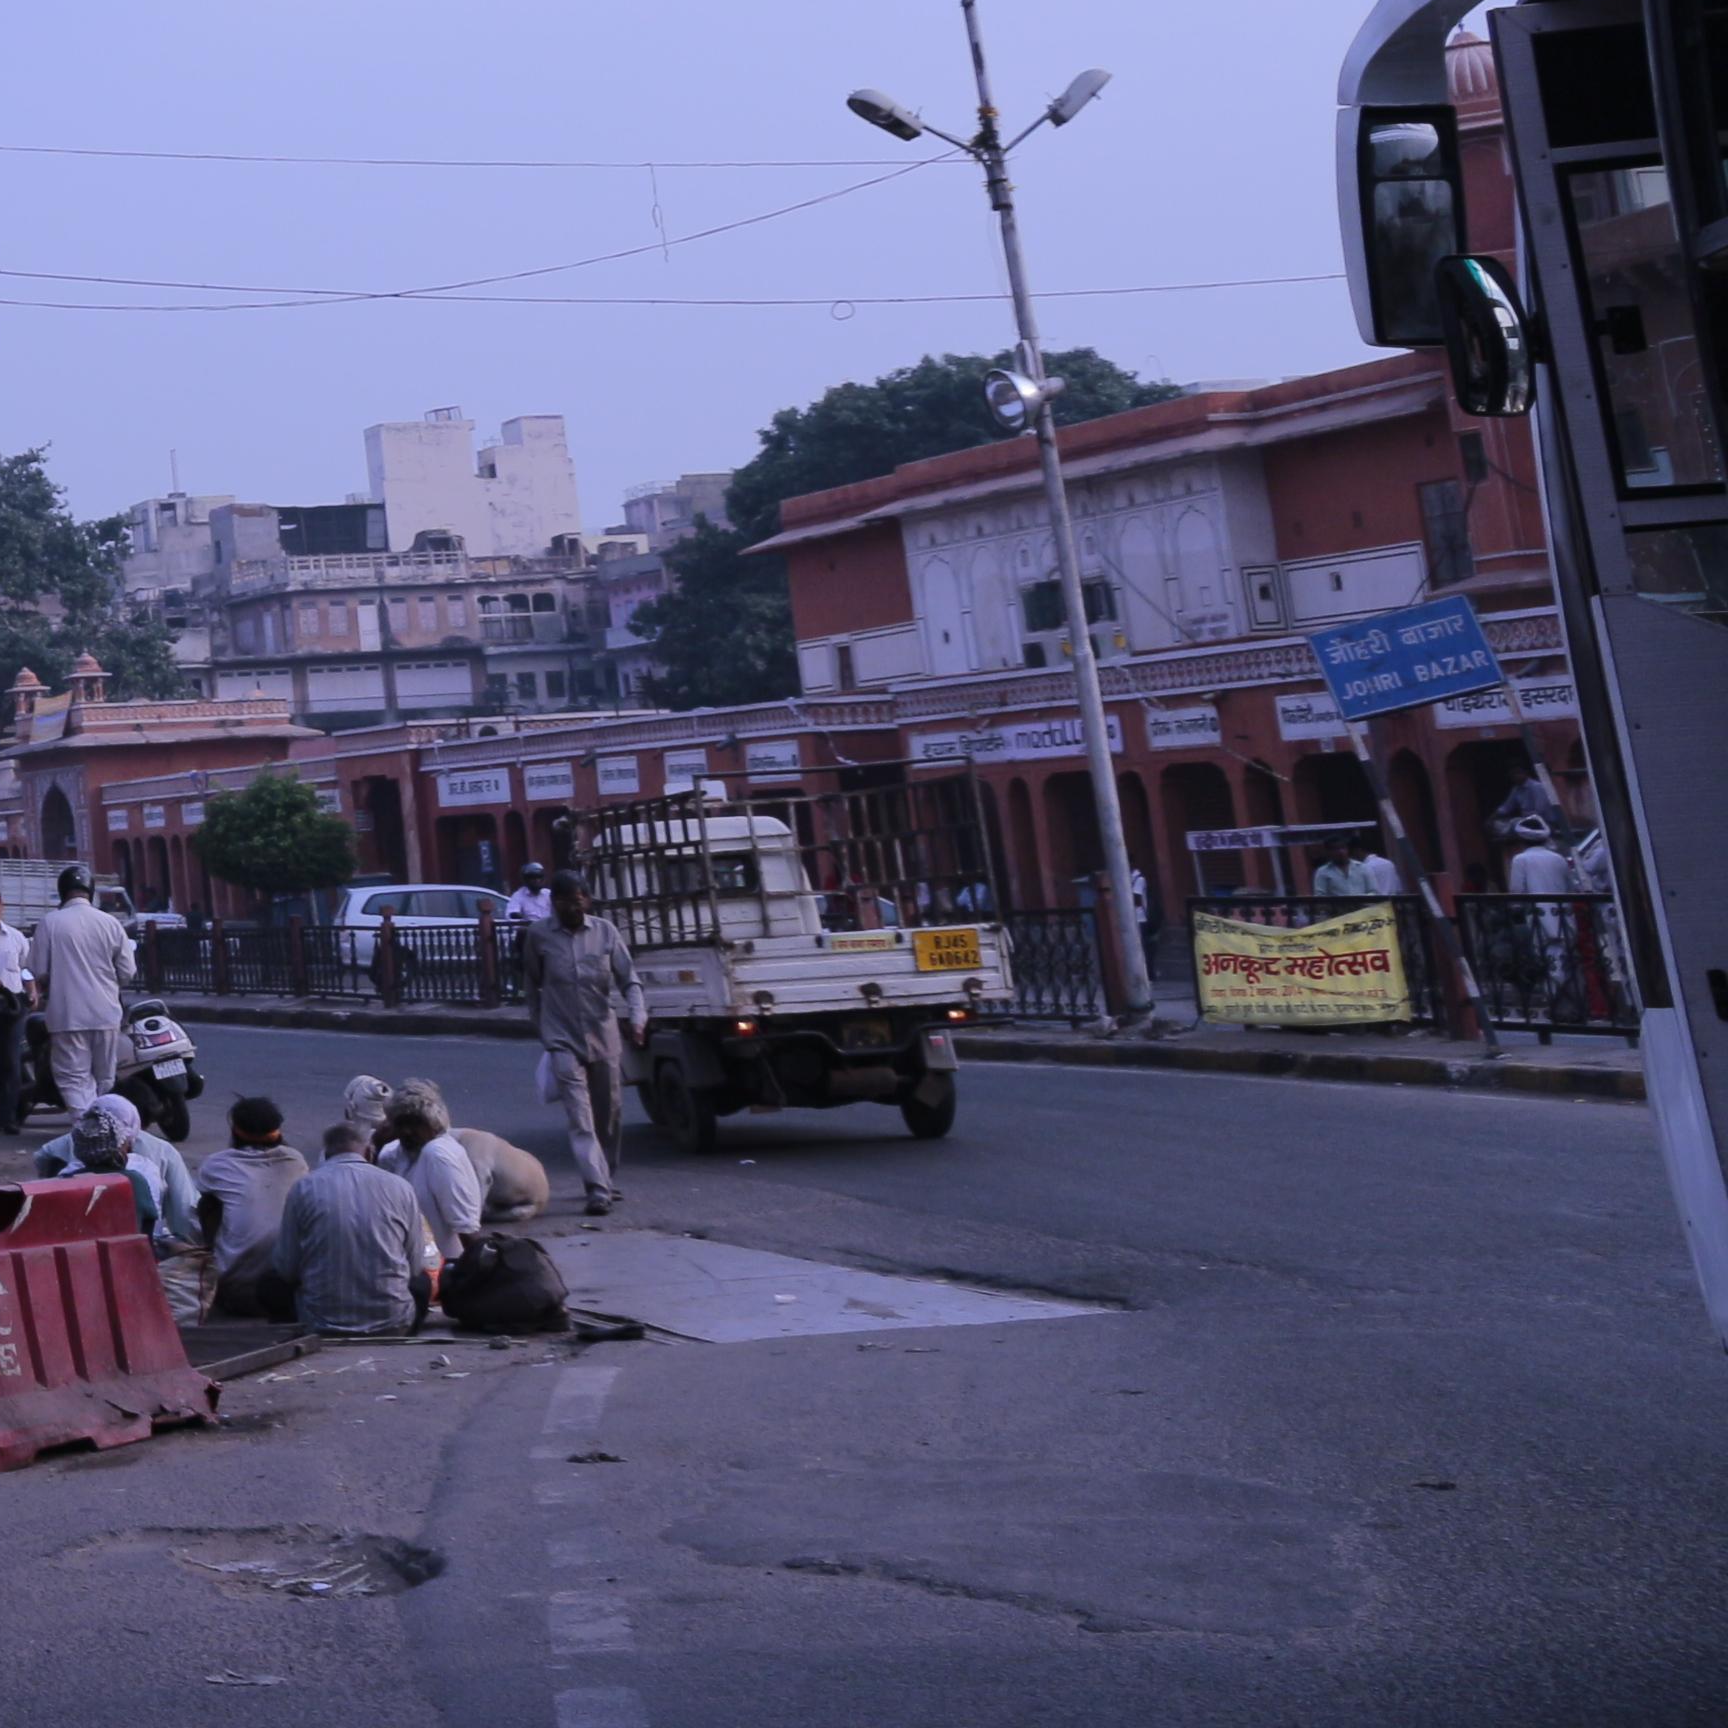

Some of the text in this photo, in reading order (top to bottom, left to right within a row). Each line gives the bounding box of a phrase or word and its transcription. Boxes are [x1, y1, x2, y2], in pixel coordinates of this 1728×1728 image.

[1397, 614, 1465, 646] बाजार
[1343, 650, 1491, 702] JOHRI BAZAR
[1202, 947, 1390, 984] अनकूट महोत्सव
